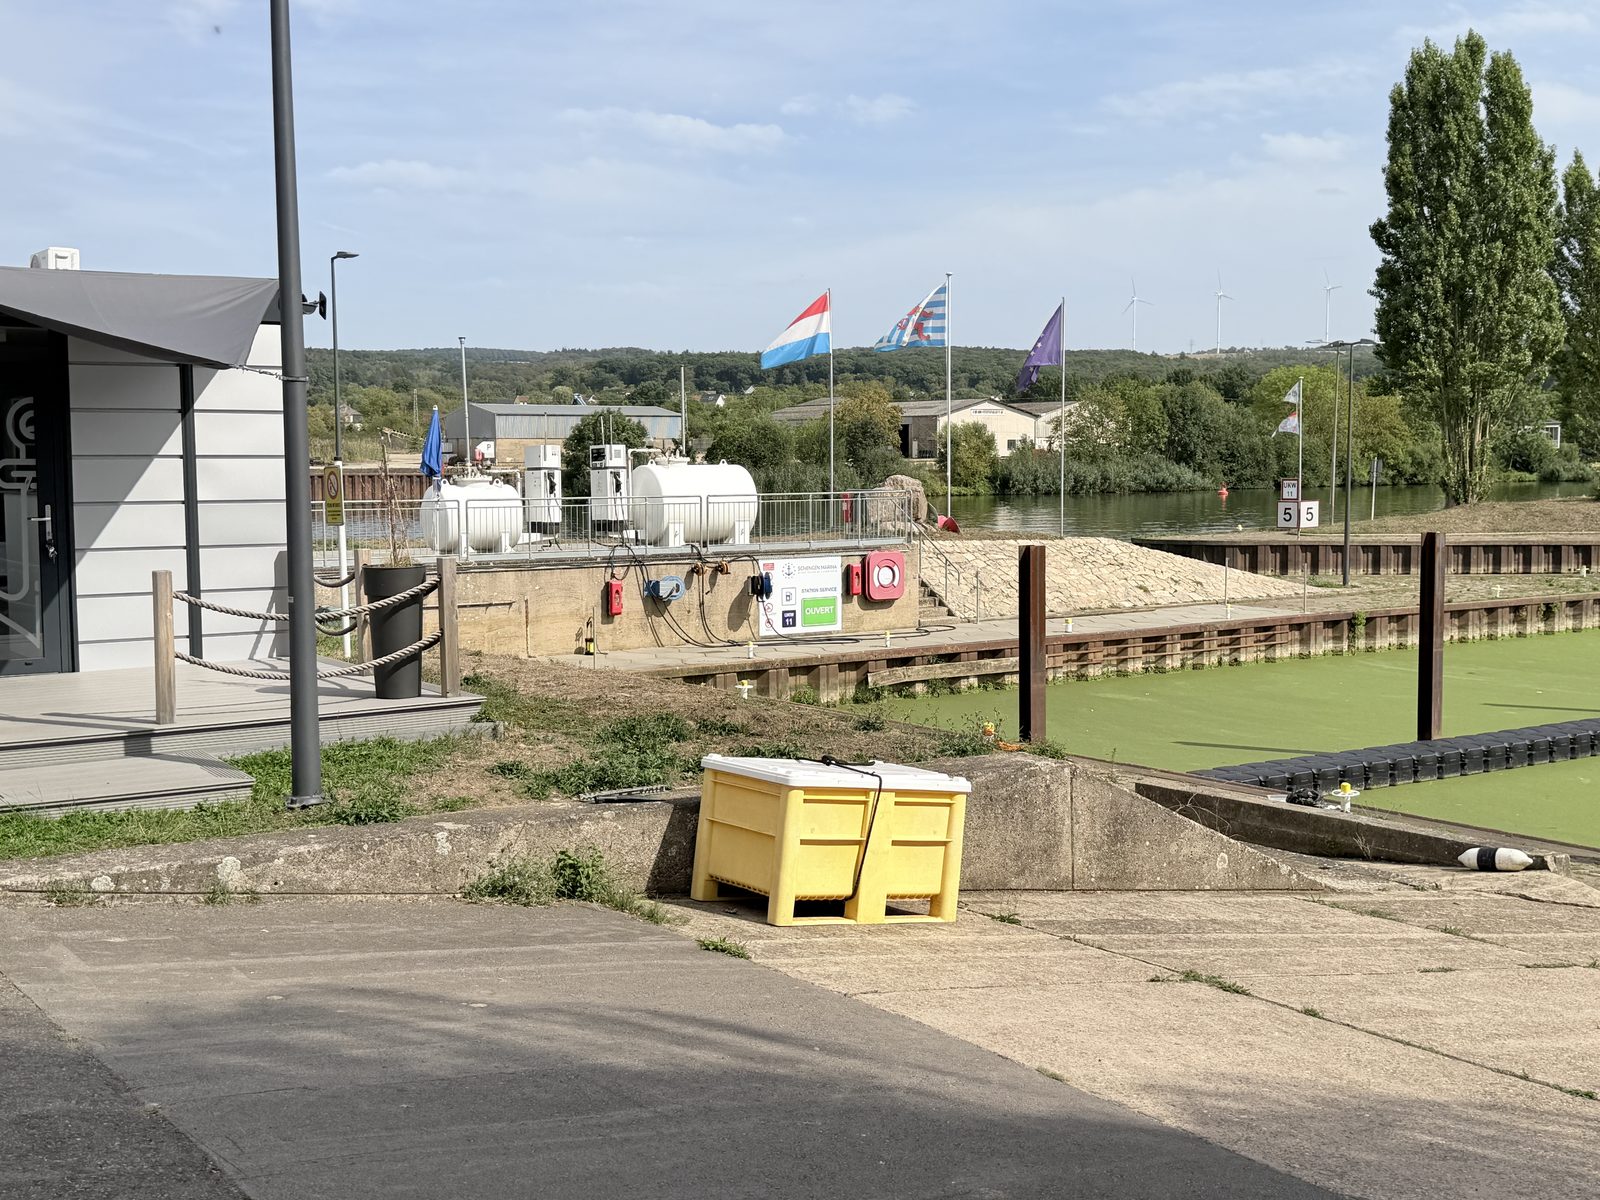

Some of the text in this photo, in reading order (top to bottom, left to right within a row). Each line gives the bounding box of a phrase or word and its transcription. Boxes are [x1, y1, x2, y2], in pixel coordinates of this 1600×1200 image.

[1283, 508, 1292, 522] 5
[1306, 506, 1314, 522] 5
[805, 606, 834, 615] OUVERT
